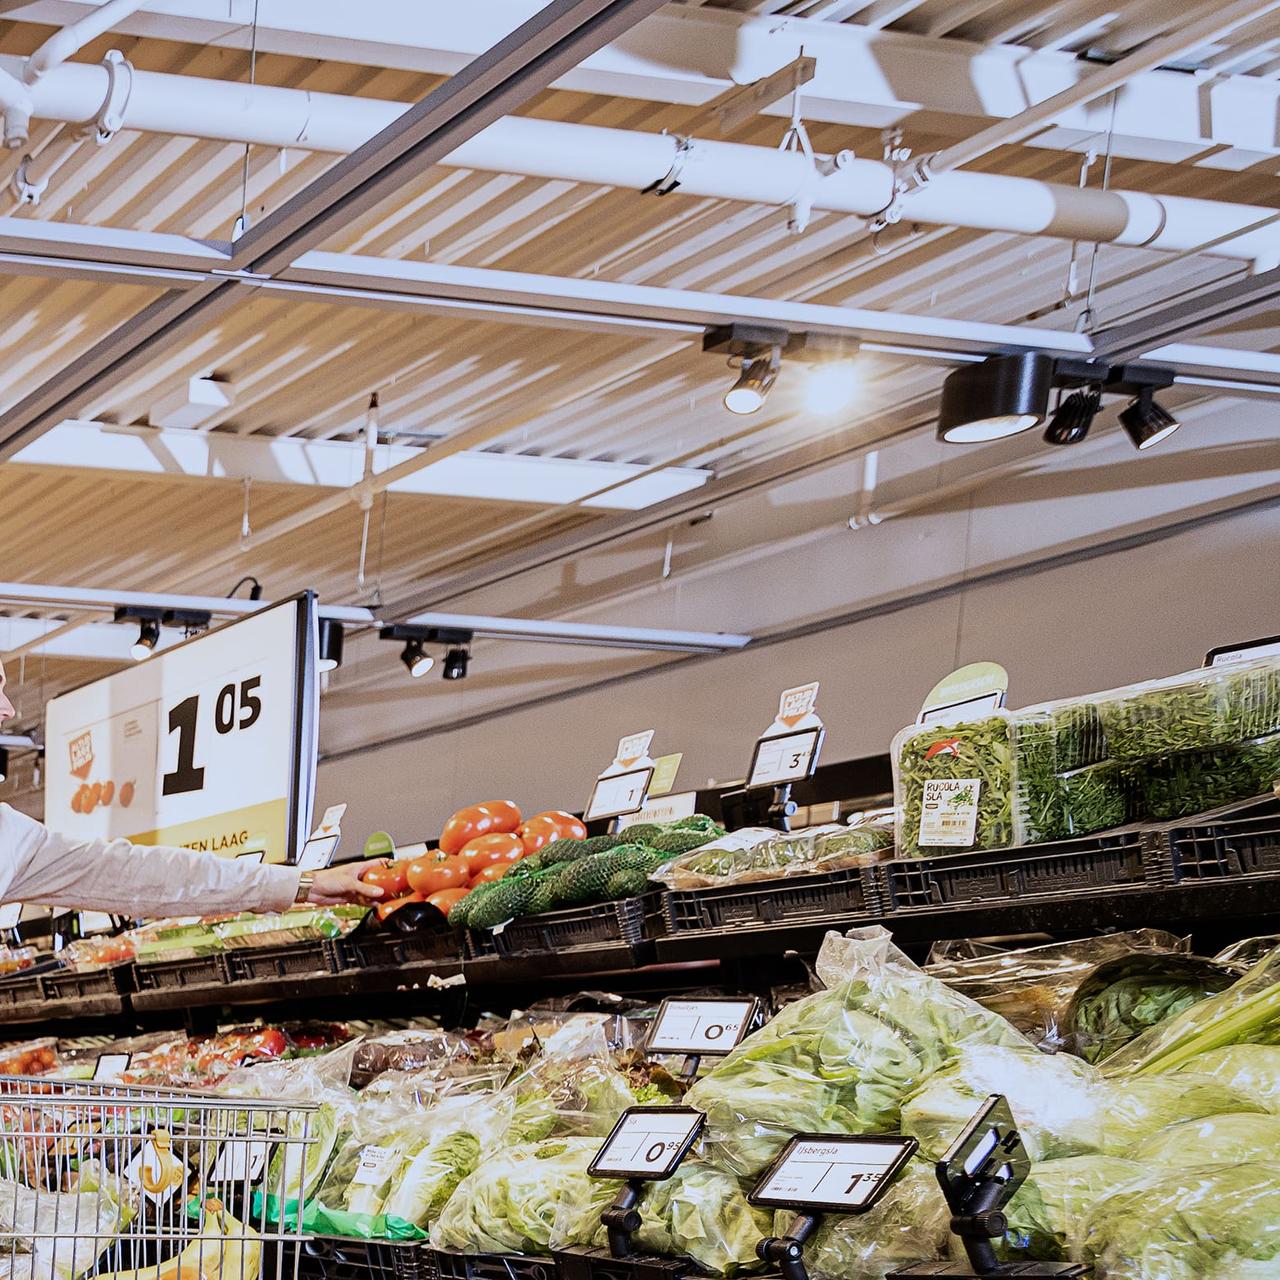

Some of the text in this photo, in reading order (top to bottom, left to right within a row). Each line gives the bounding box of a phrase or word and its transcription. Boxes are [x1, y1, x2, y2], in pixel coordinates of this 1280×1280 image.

[926, 781, 960, 792] RUCOLA
[926, 792, 943, 801] SLA
[212, 830, 248, 851] LAAG
